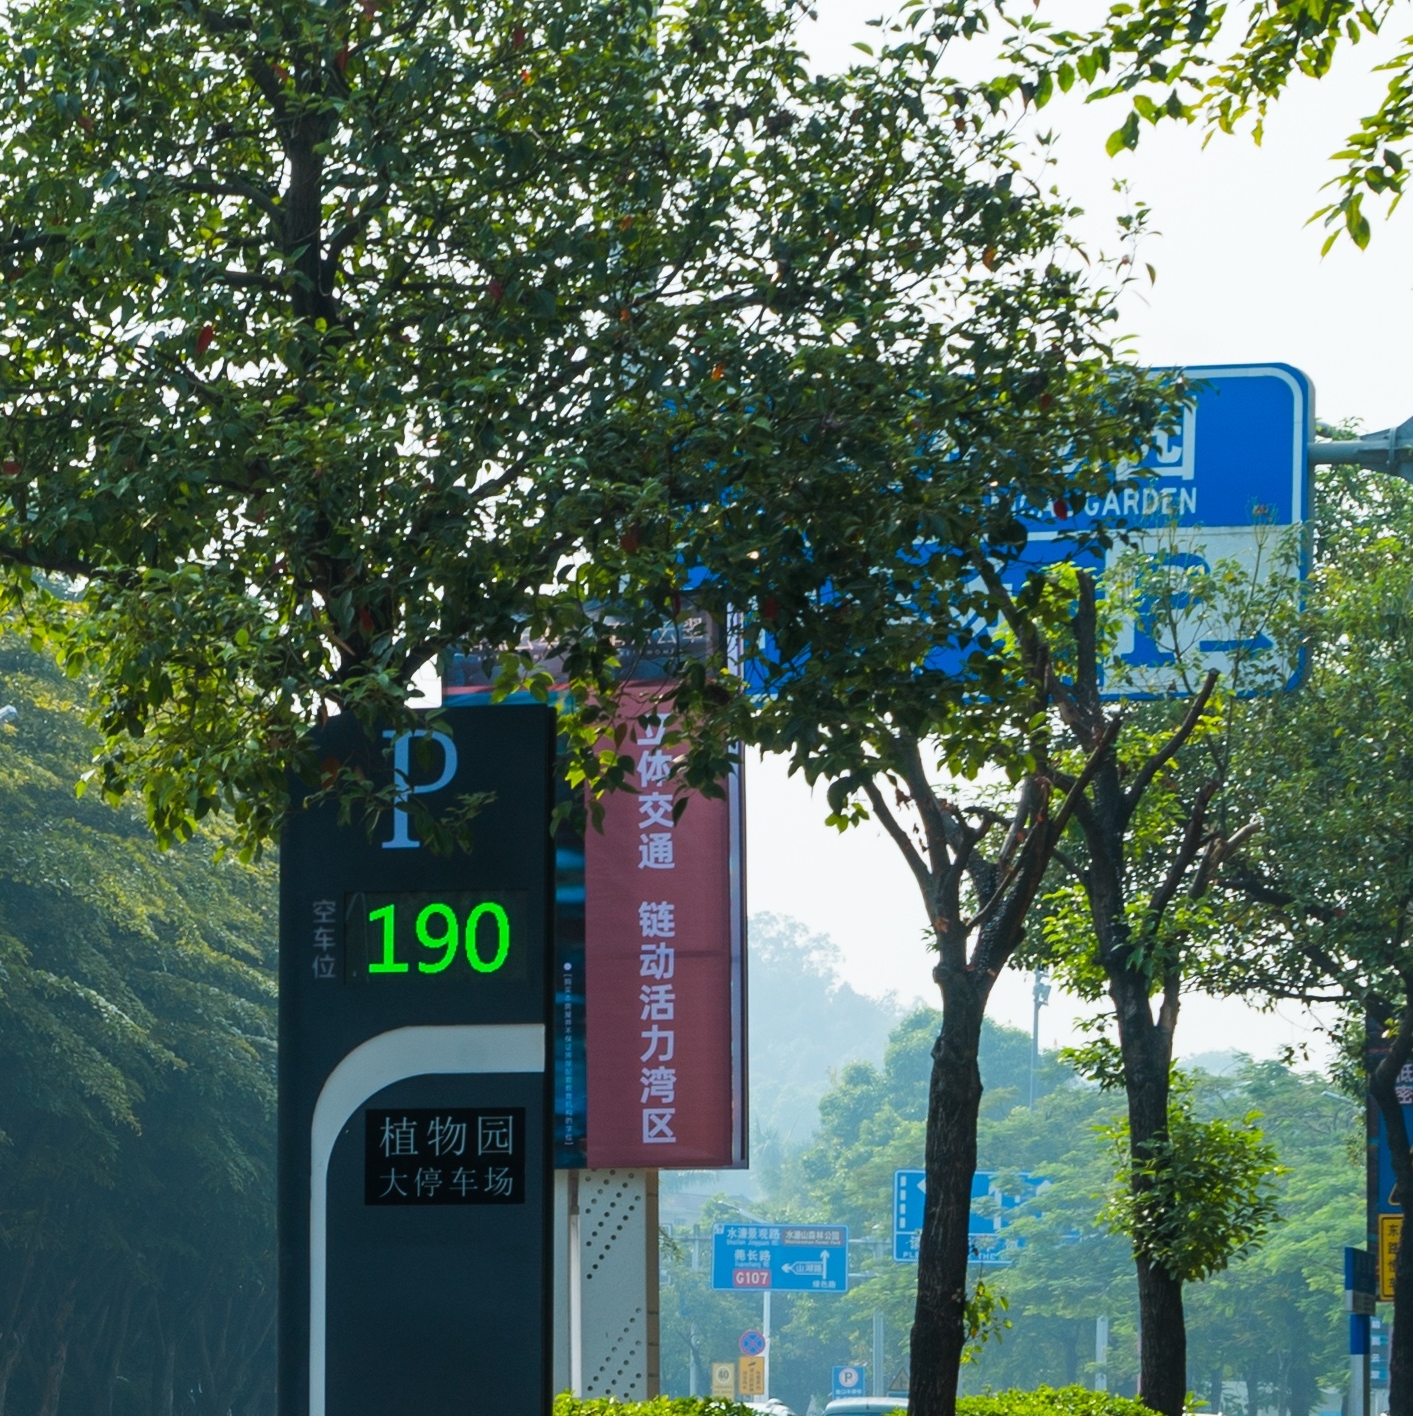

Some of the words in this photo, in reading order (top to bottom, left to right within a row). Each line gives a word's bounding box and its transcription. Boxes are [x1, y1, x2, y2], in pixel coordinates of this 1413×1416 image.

[1084, 487, 1197, 516] GARDEN
[382, 729, 458, 849] P
[636, 713, 675, 869] 立体交通
[311, 899, 336, 980] 空车位
[369, 902, 510, 974] 190
[638, 901, 677, 1144] 链动活力湾区
[379, 1115, 513, 1158] 植物园
[379, 1166, 513, 1198] 大停车场
[736, 1272, 769, 1284] G107
[717, 1369, 730, 1380] 40
